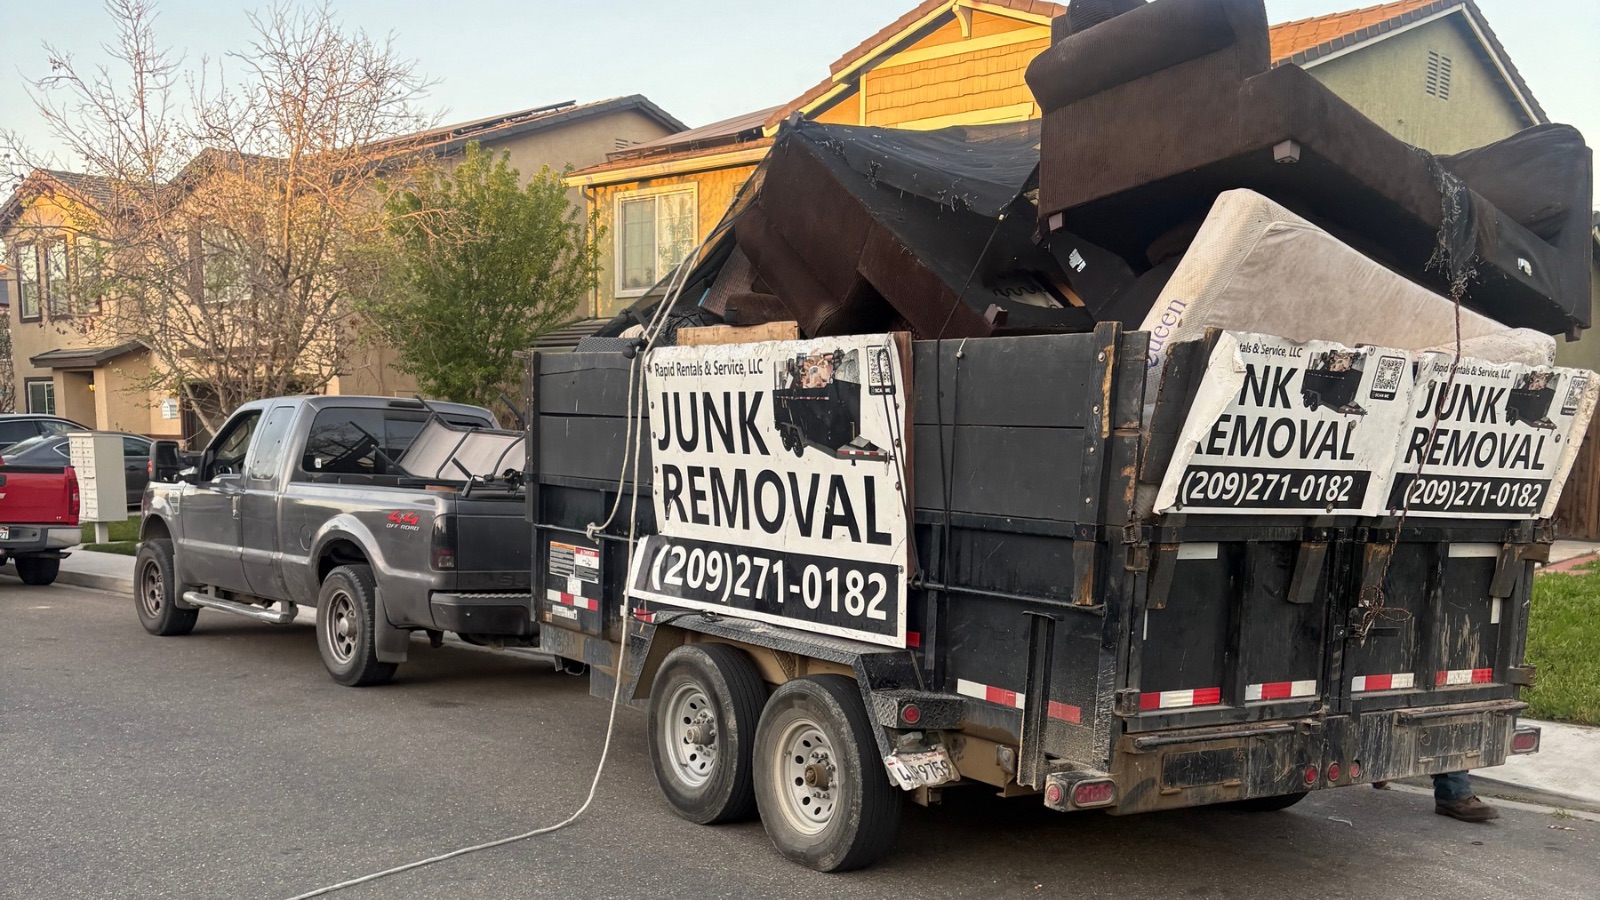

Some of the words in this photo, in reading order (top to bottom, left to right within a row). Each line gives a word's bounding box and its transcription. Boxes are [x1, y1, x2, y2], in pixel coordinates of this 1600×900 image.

[654, 362, 675, 381] Rapid
[676, 360, 703, 377] Rentals
[704, 360, 712, 375] &
[713, 359, 747, 378] Service,
[748, 358, 764, 375] LLC
[1239, 341, 1252, 354] tals
[1252, 343, 1260, 354] &
[1260, 344, 1287, 358] Service,
[1288, 346, 1303, 358] LLC
[1432, 362, 1449, 375] Rapid
[1449, 363, 1470, 375] Rntals
[1470, 365, 1477, 376] &
[1477, 366, 1499, 379] Service,
[1500, 369, 1511, 379] LLC
[1238, 363, 1299, 409] NK
[1415, 380, 1507, 425] JUNK
[658, 390, 771, 456] JUNK
[1194, 413, 1356, 461] EMOVAL
[1403, 426, 1546, 471] REMOVAL
[662, 463, 893, 547] REMOVAL
[1181, 470, 1354, 506] (209)271-0182
[1402, 478, 1543, 511] (209)271-0182
[651, 543, 888, 621] (209)271-0182
